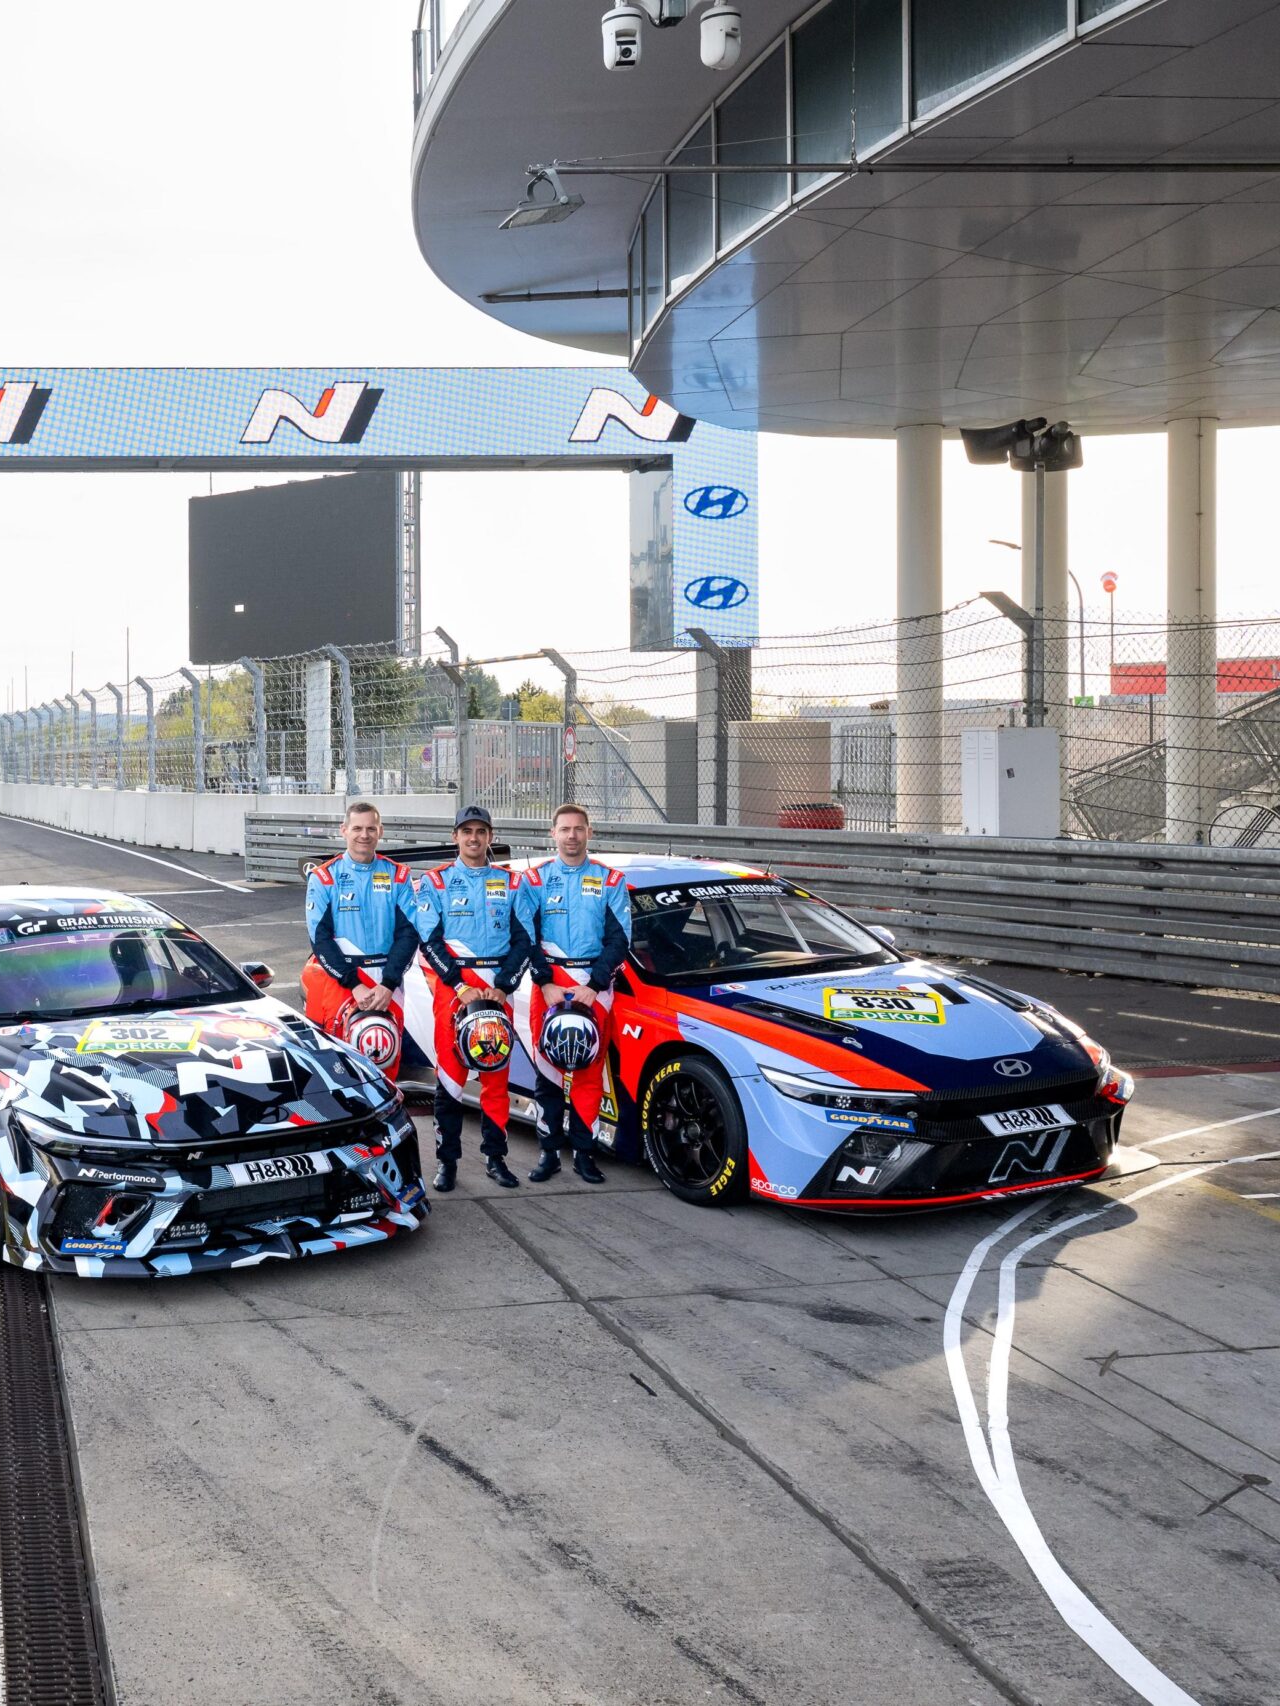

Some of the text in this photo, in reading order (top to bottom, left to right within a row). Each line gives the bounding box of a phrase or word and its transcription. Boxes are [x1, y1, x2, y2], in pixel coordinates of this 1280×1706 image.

[688, 886, 727, 897] GRAN
[725, 884, 783, 894] TURISMO
[56, 917, 96, 927] GRAN
[102, 915, 163, 925] TURISMO
[851, 995, 916, 1011] 830
[862, 1011, 933, 1022] DEKRA
[110, 1028, 169, 1040] 302
[115, 1042, 182, 1051] DEKRA
[830, 1113, 910, 1129] GOODYEAR
[994, 1110, 1035, 1131] H&R
[245, 1159, 292, 1182] H&R
[709, 1157, 736, 1196] EAGLE
[98, 1171, 157, 1184] Performance
[751, 1177, 797, 1195] sparco
[64, 1242, 124, 1251] GOODYEAR
